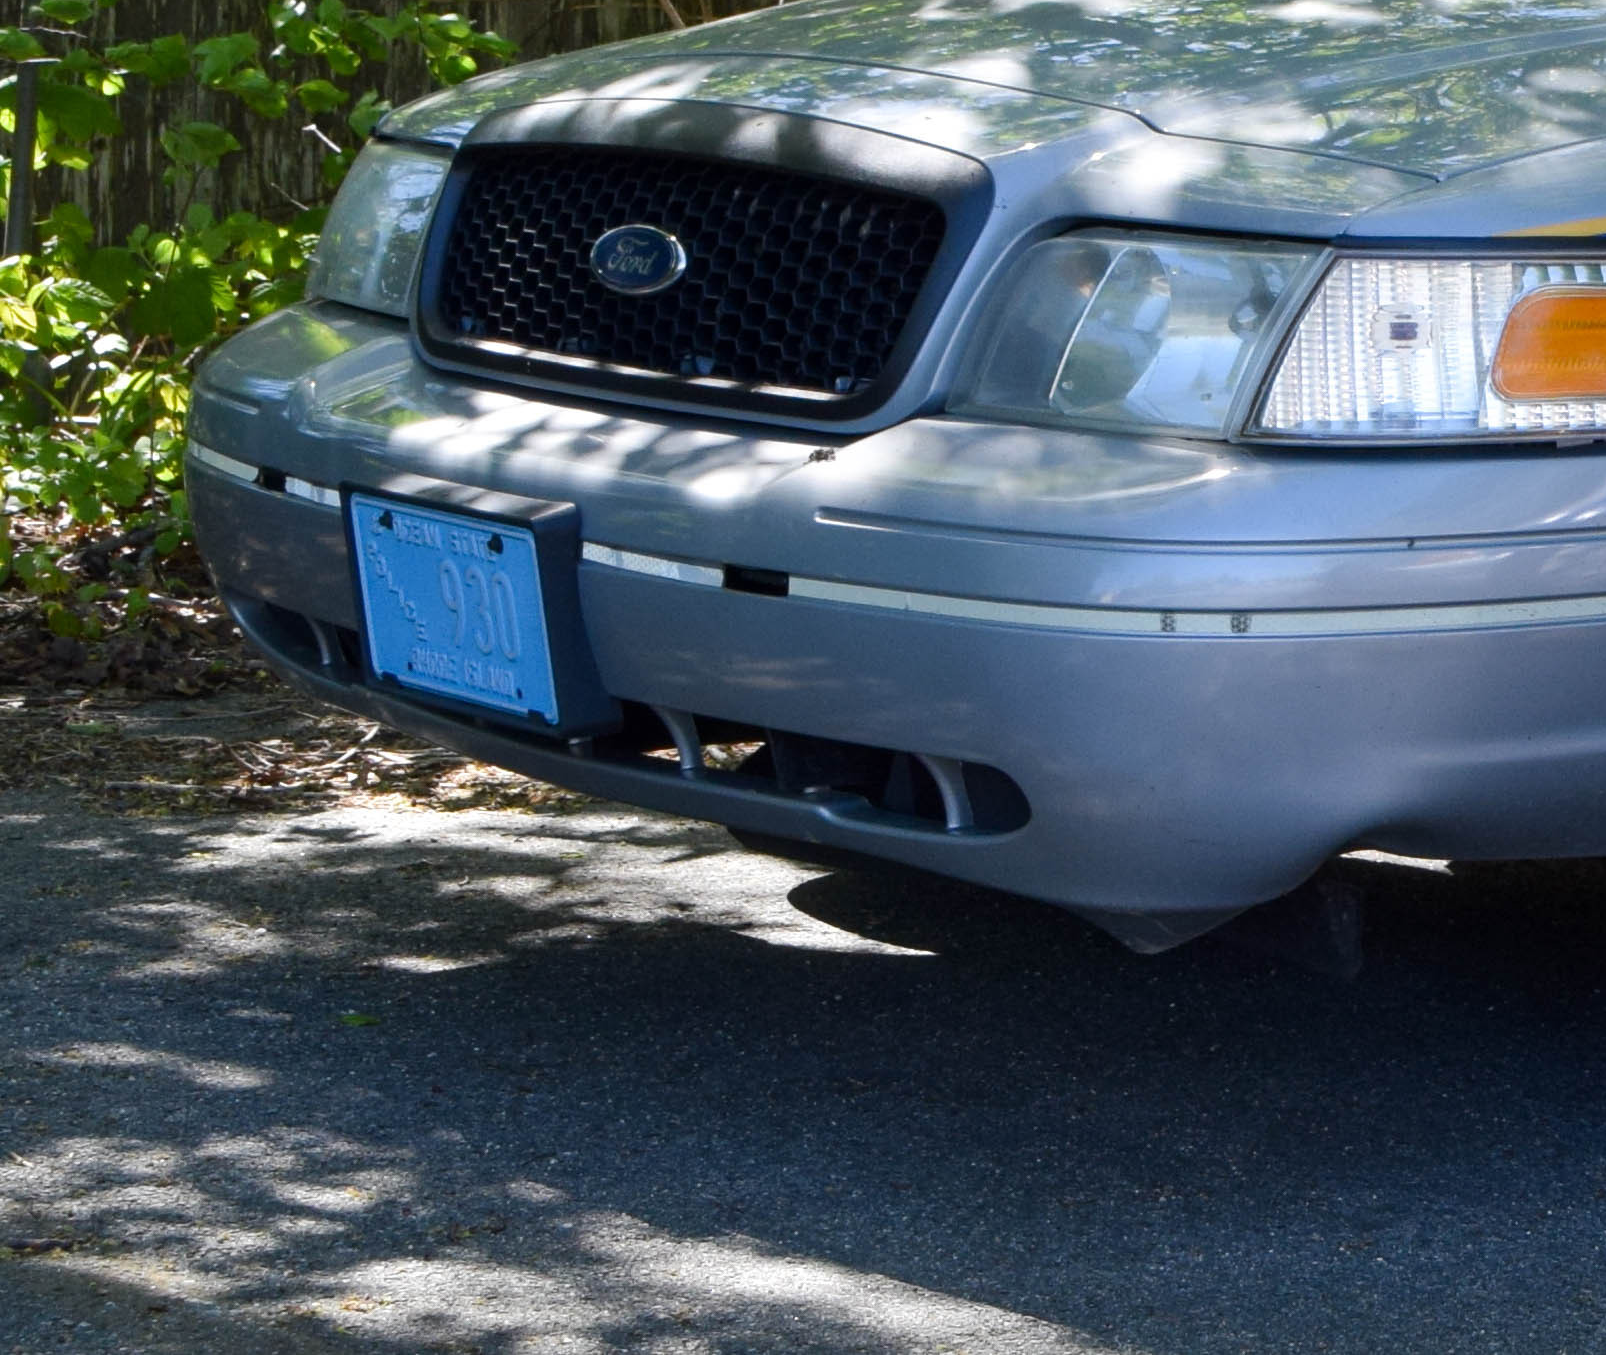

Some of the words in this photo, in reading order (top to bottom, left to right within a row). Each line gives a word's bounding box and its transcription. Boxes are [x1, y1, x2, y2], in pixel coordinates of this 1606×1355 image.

[608, 236, 659, 275] Ford
[367, 541, 428, 642] POLICE
[441, 559, 519, 659] 930
[411, 647, 458, 684] RHODE
[464, 658, 514, 697] ISLAND
